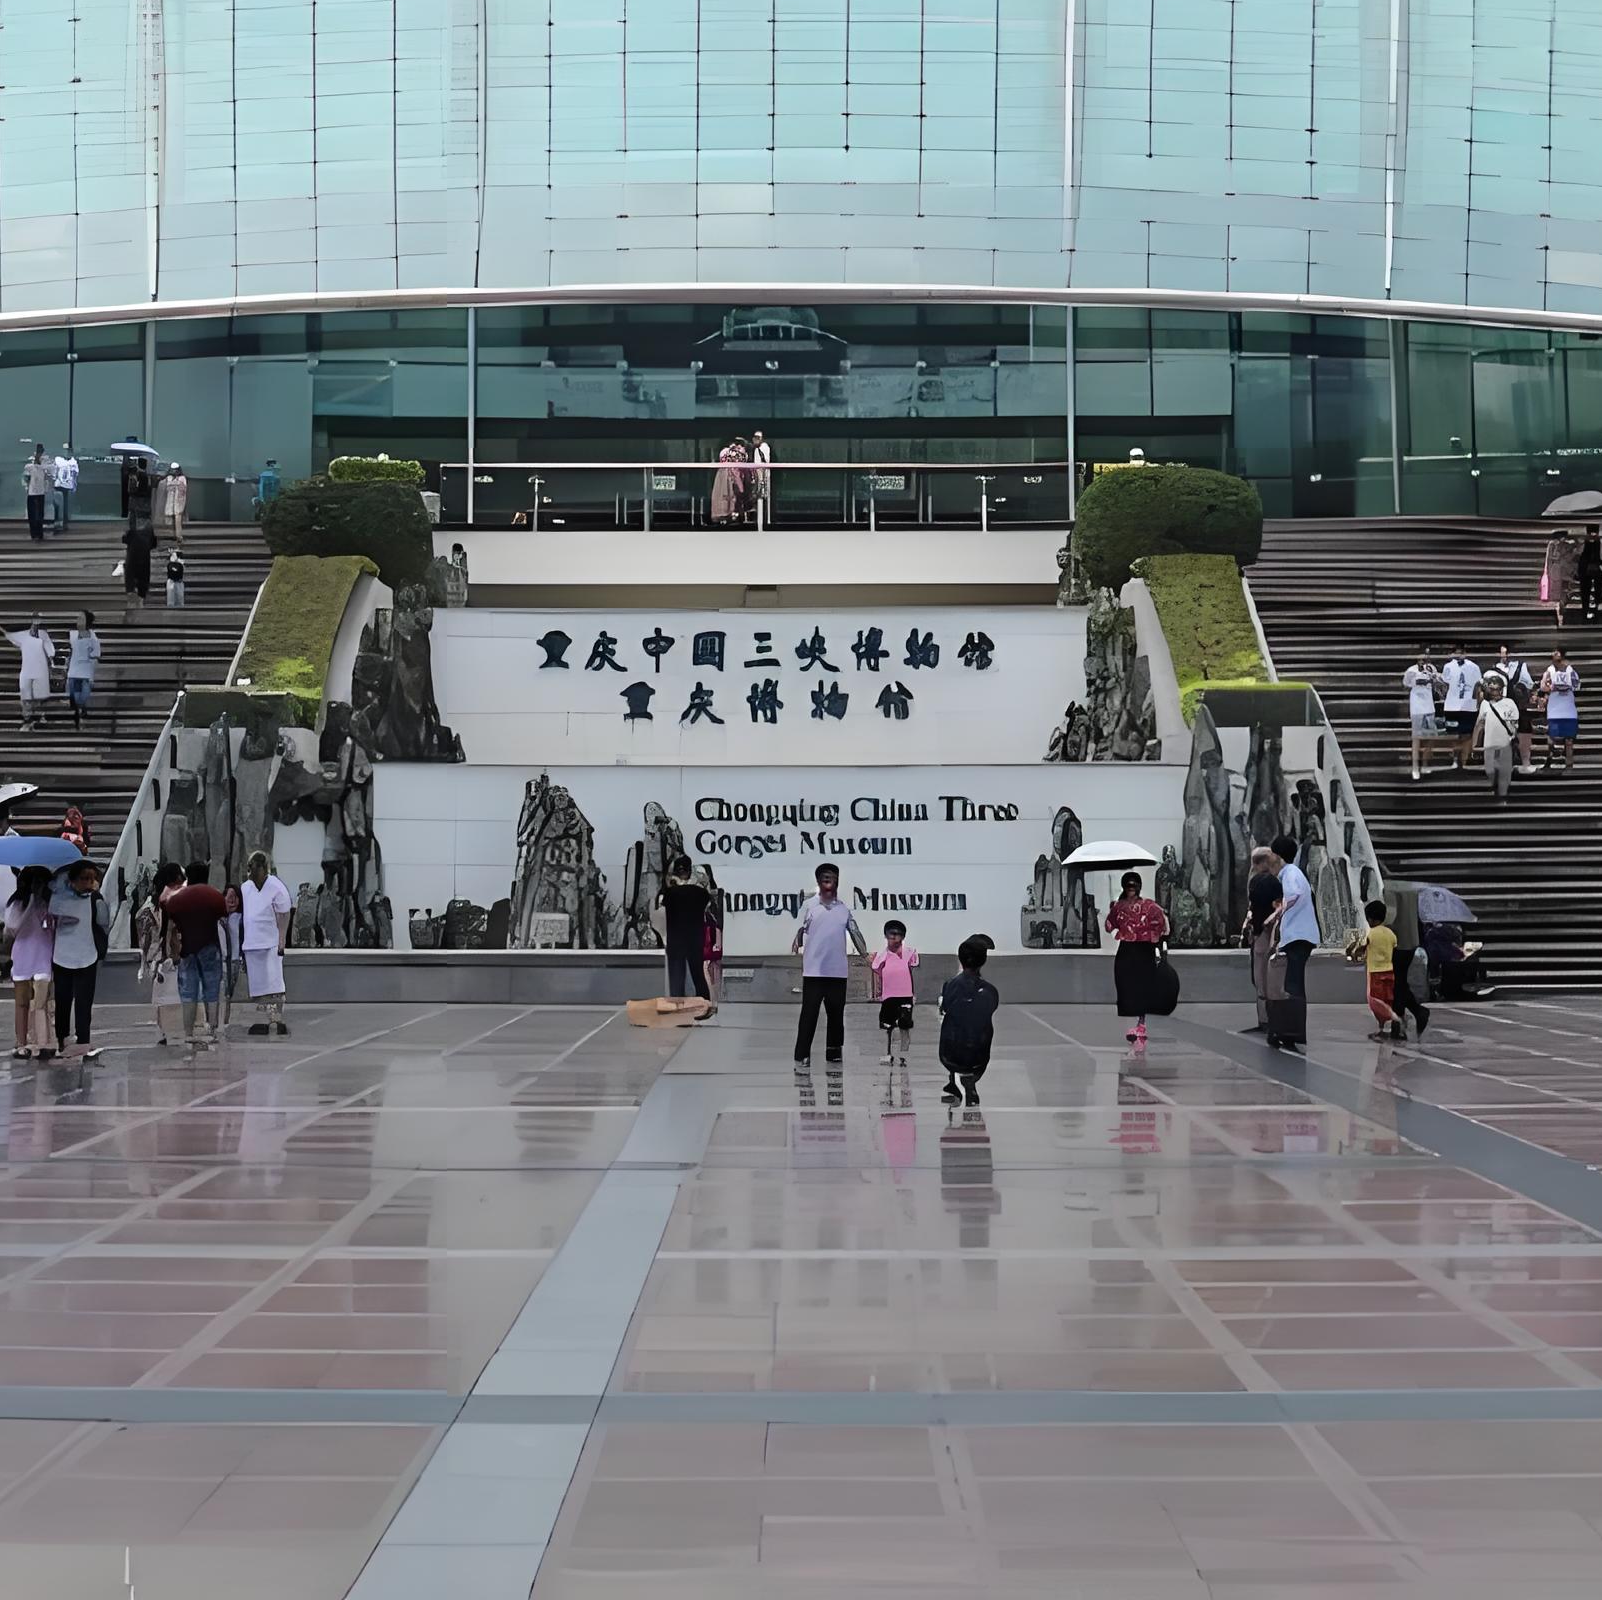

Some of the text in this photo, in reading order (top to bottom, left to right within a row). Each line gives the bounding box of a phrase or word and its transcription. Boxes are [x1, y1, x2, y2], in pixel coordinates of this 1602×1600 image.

[850, 797, 929, 822] China
[938, 796, 1019, 822] Three
[800, 831, 912, 855] Museum
[853, 886, 967, 912] Museum
